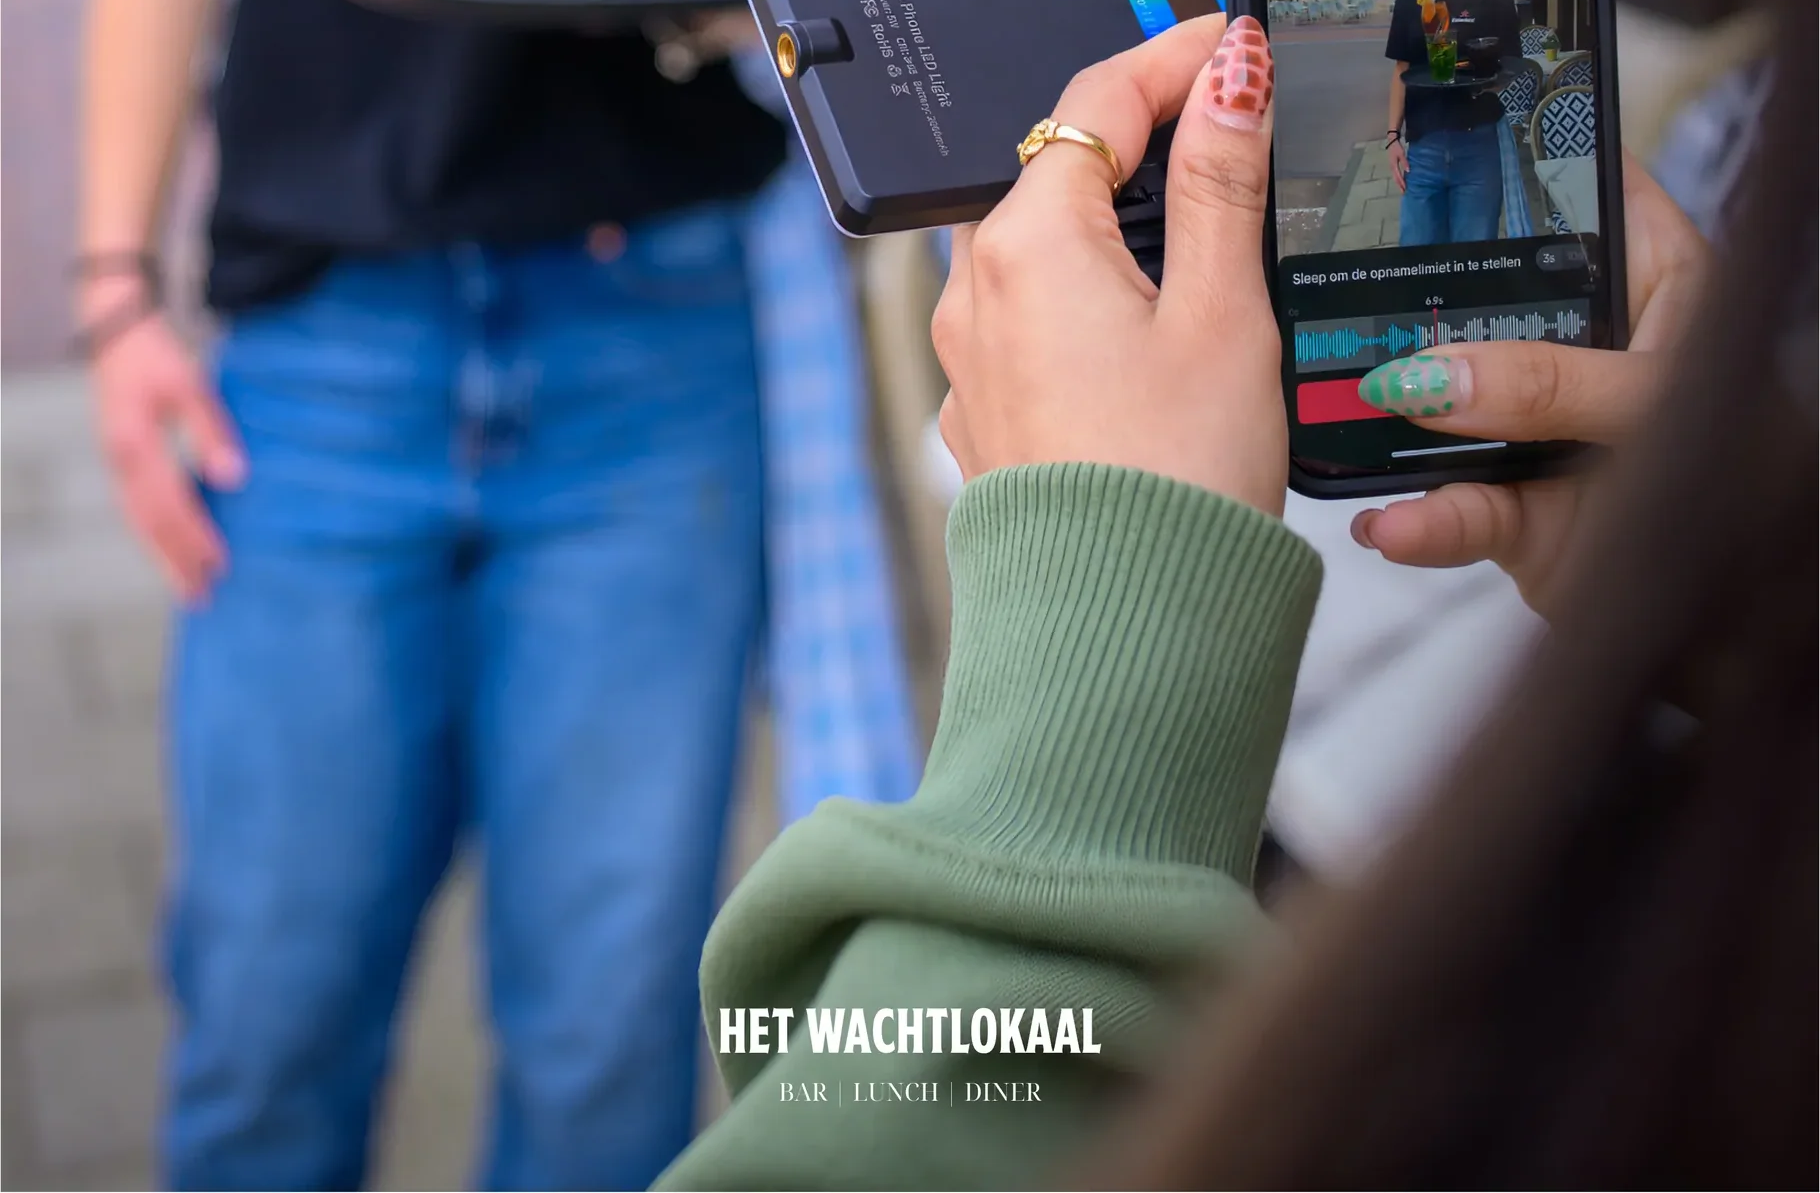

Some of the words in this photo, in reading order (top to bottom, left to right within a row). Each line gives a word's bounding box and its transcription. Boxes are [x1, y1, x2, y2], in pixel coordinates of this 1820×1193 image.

[870, 23, 895, 58] RoHS
[900, 2, 925, 44] Phone
[918, 46, 938, 71] LED
[928, 73, 953, 108] Light
[1292, 272, 1327, 286] Sleep
[1329, 271, 1349, 282] om
[1351, 268, 1367, 280] de
[1370, 262, 1451, 281] opnamelimiet
[1453, 260, 1465, 272] in
[1467, 260, 1479, 271] te
[1482, 256, 1521, 270] stellen
[1542, 253, 1556, 264] 3s
